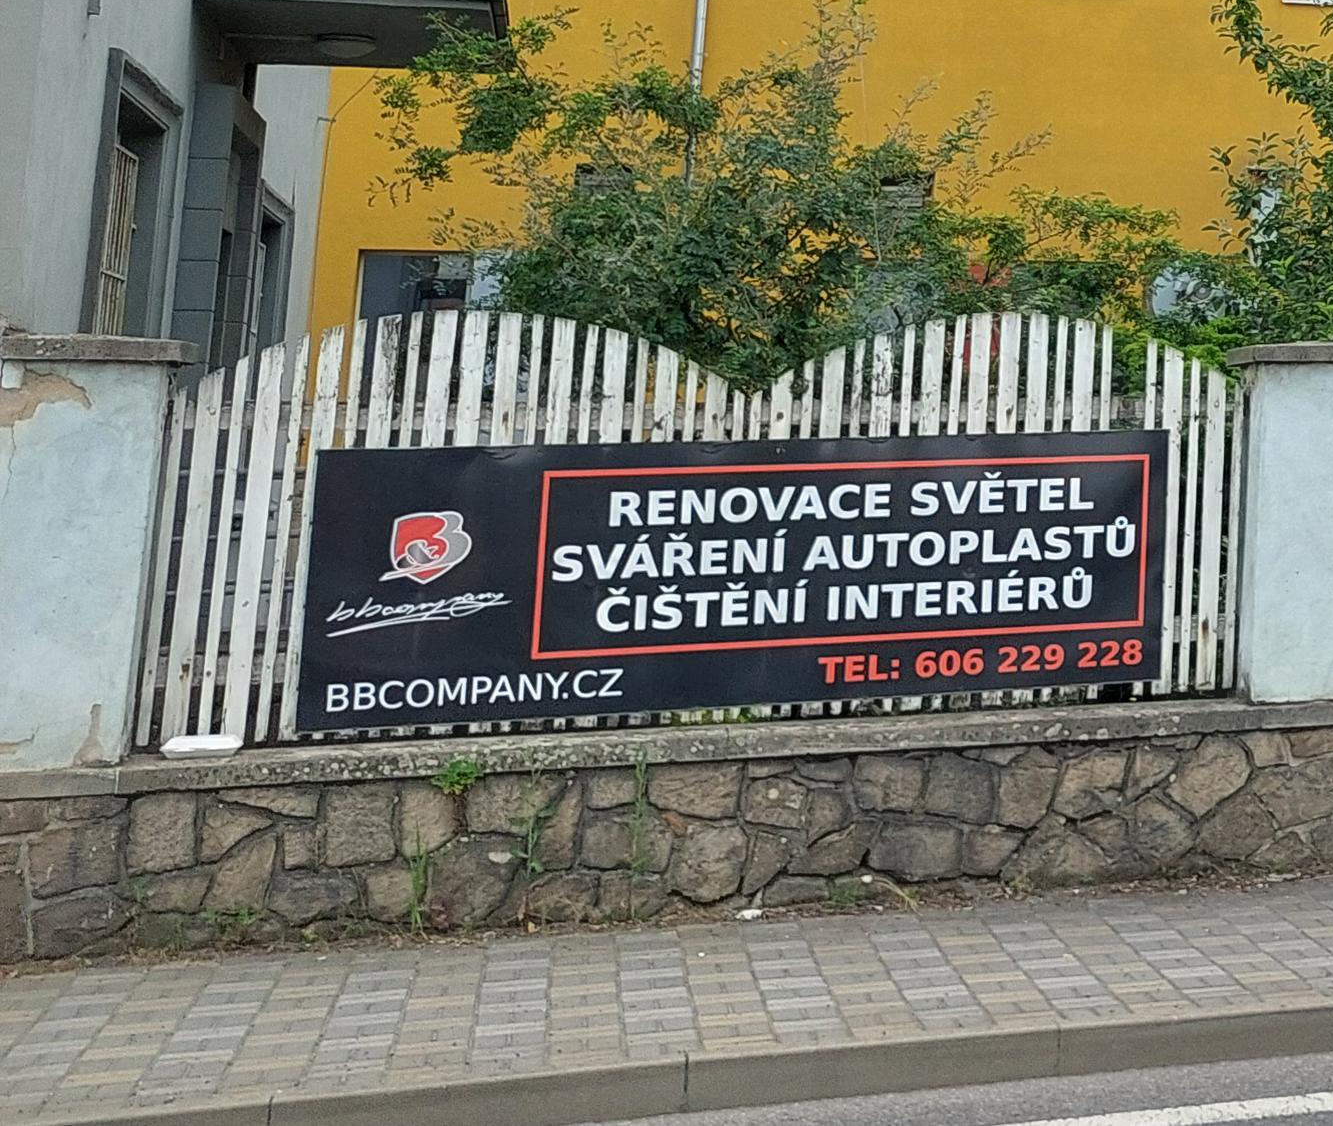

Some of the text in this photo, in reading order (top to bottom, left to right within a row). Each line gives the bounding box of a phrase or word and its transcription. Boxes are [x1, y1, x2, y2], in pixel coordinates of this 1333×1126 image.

[608, 471, 1095, 527] RENOVACE SVĚTEL
[551, 515, 1136, 582] SVÁŘENÍ AUTOPLASTŮ
[595, 566, 1093, 633] ČIŠTĚNÍ INTERIÉRŮ
[818, 639, 1143, 684] TEL: 606 229 228
[325, 668, 624, 713] BBCOMPANY.CZ
